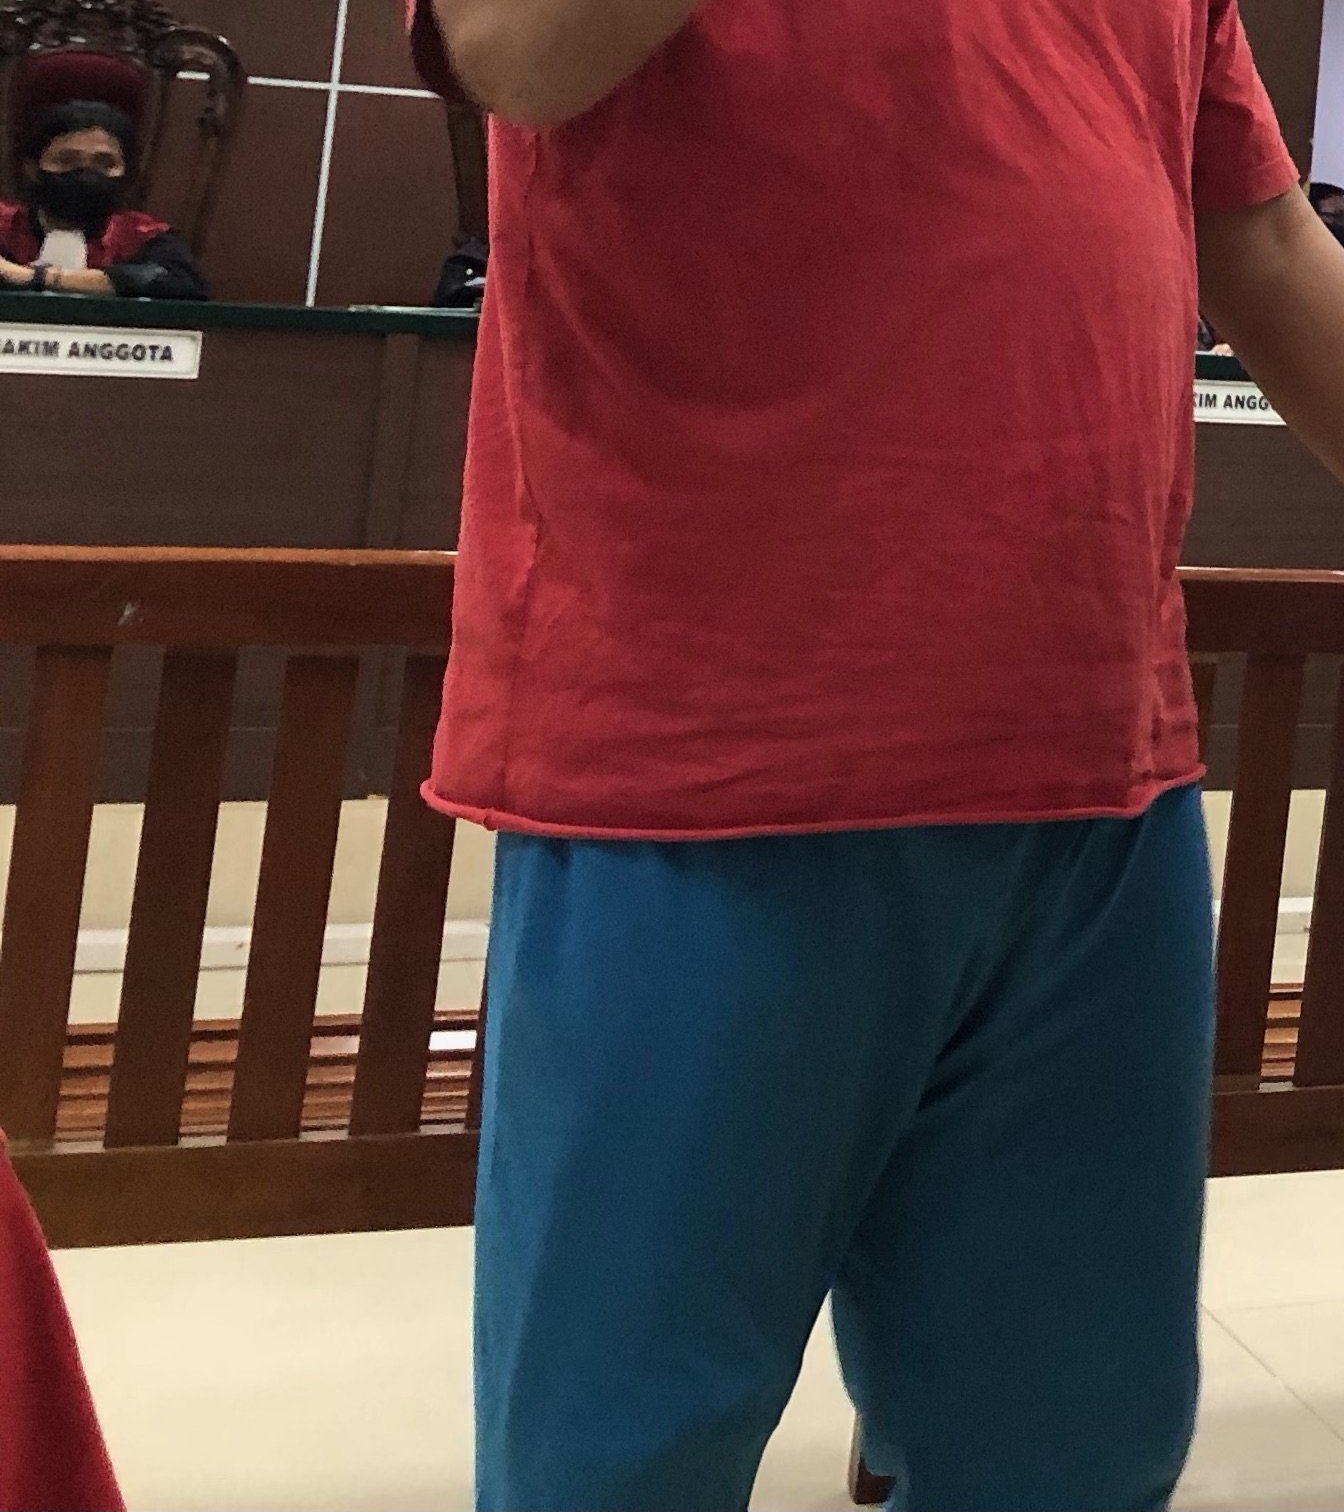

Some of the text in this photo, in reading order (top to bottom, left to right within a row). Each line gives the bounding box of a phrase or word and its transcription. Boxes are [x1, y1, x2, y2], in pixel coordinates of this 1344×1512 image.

[0, 339, 174, 362] AKIM ANGGOTA
[1223, 394, 1270, 411] ANGG
